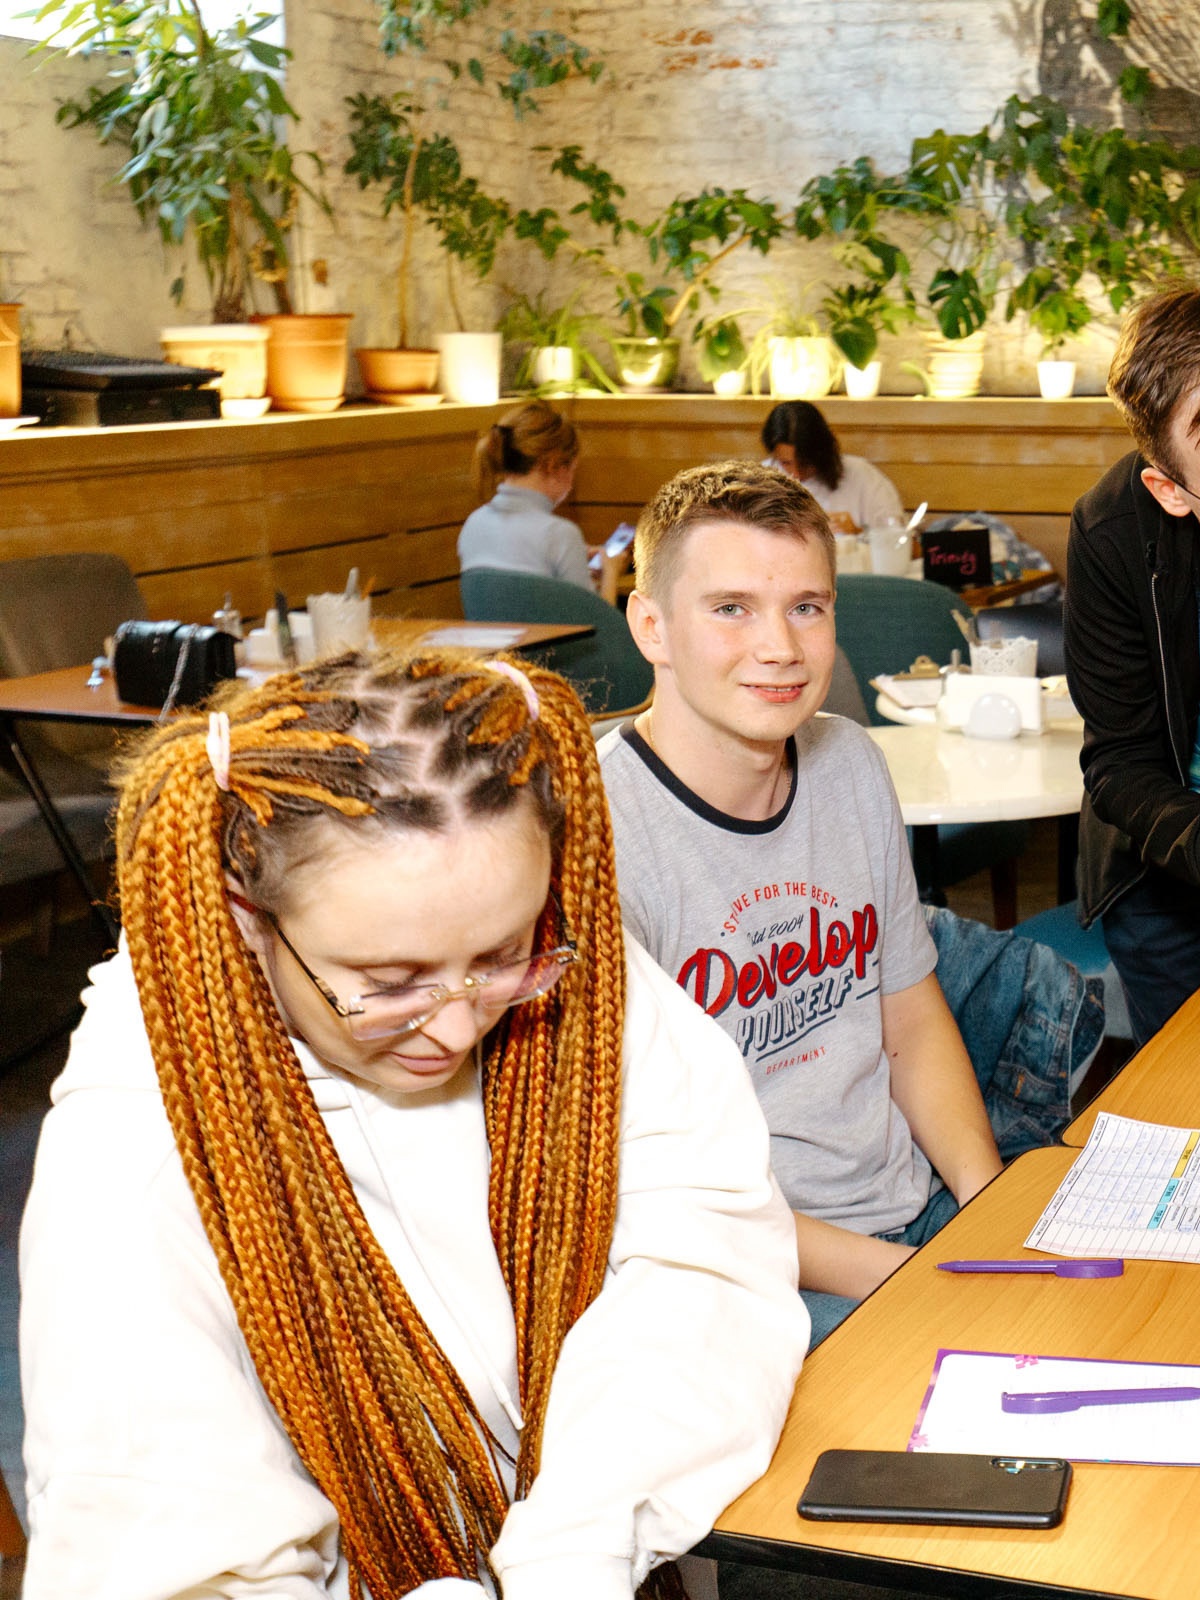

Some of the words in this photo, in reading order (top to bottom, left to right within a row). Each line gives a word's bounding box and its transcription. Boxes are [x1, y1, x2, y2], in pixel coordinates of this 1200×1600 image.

[753, 883, 781, 902] FOR
[784, 881, 807, 896] THE
[811, 885, 837, 908] BEST
[767, 914, 804, 940] 2004
[676, 903, 879, 1020] Develop
[765, 1046, 826, 1075] DEPARTMENT
